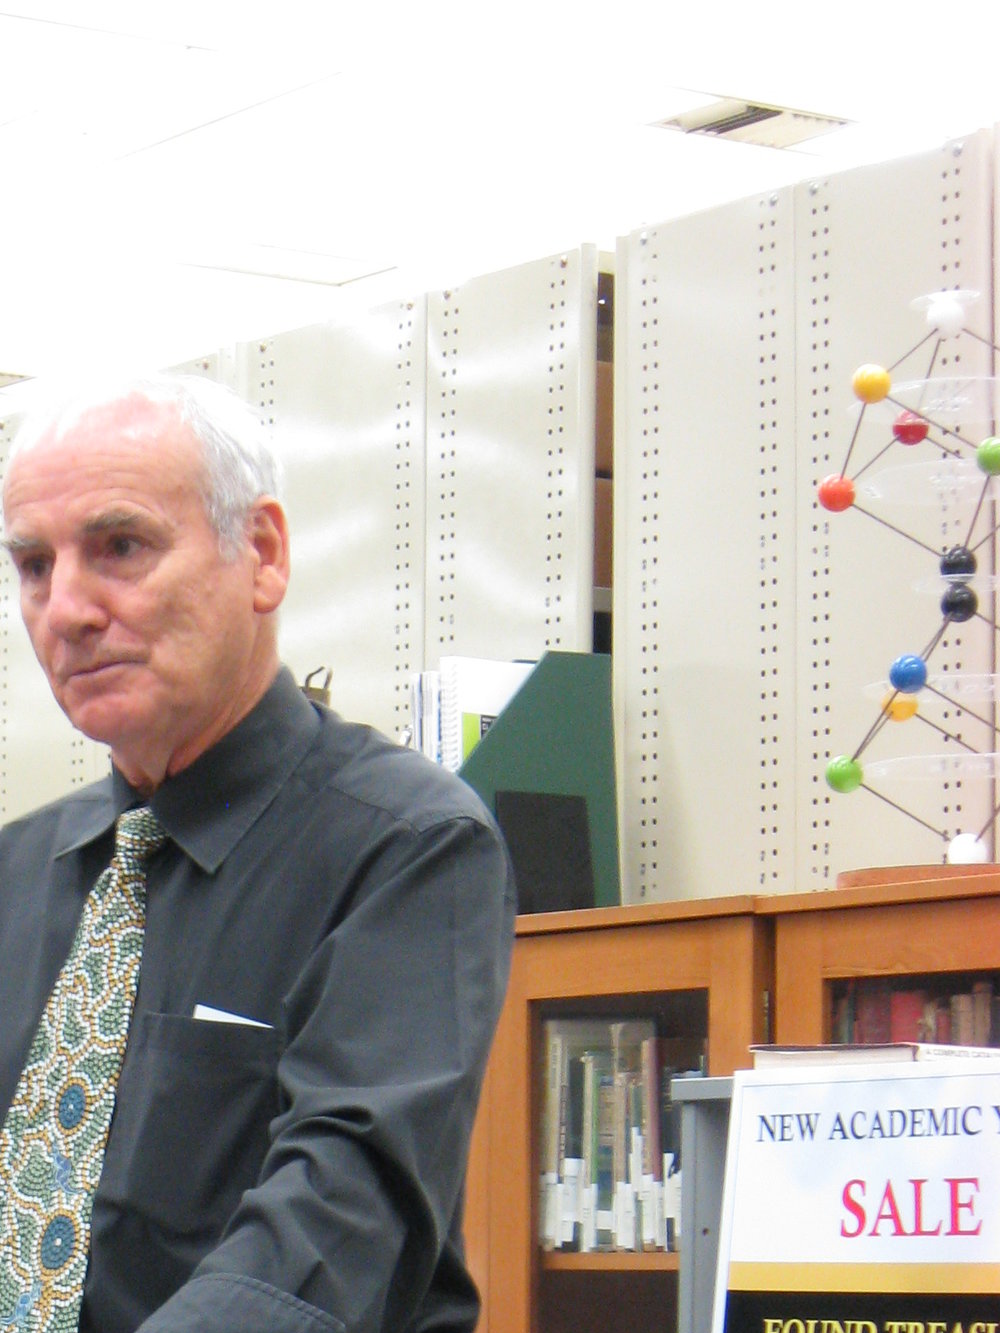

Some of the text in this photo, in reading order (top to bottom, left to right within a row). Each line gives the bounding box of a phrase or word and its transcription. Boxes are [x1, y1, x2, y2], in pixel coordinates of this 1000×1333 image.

[756, 1112, 821, 1142] NEW
[828, 1105, 982, 1140] ACADEMIC
[840, 1177, 983, 1239] SALE
